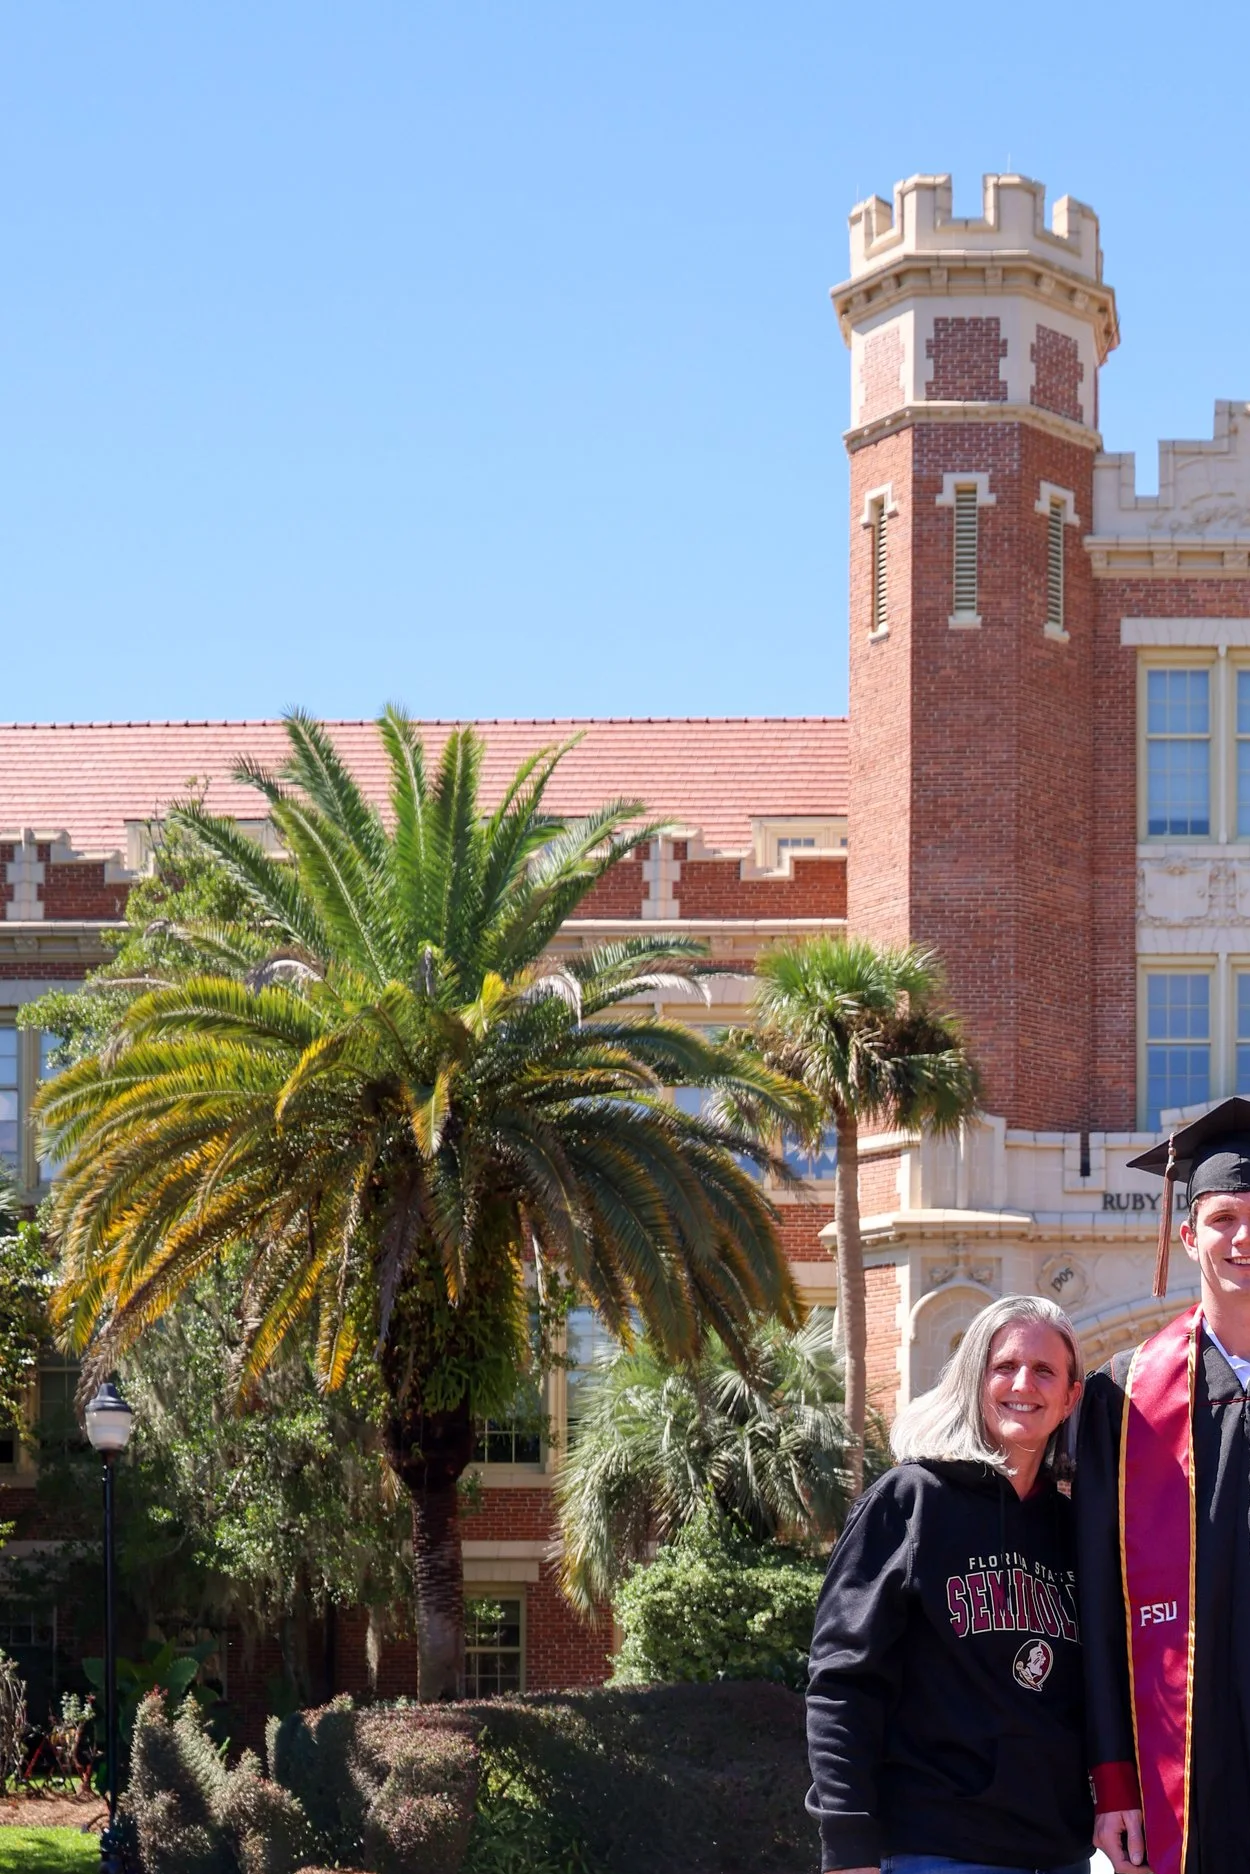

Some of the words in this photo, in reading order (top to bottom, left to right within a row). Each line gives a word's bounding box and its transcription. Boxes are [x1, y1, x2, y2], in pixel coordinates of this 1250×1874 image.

[1102, 1192, 1162, 1211] RUBY
[1034, 1560, 1077, 1583] STAE
[1139, 1600, 1178, 1628] FSU
